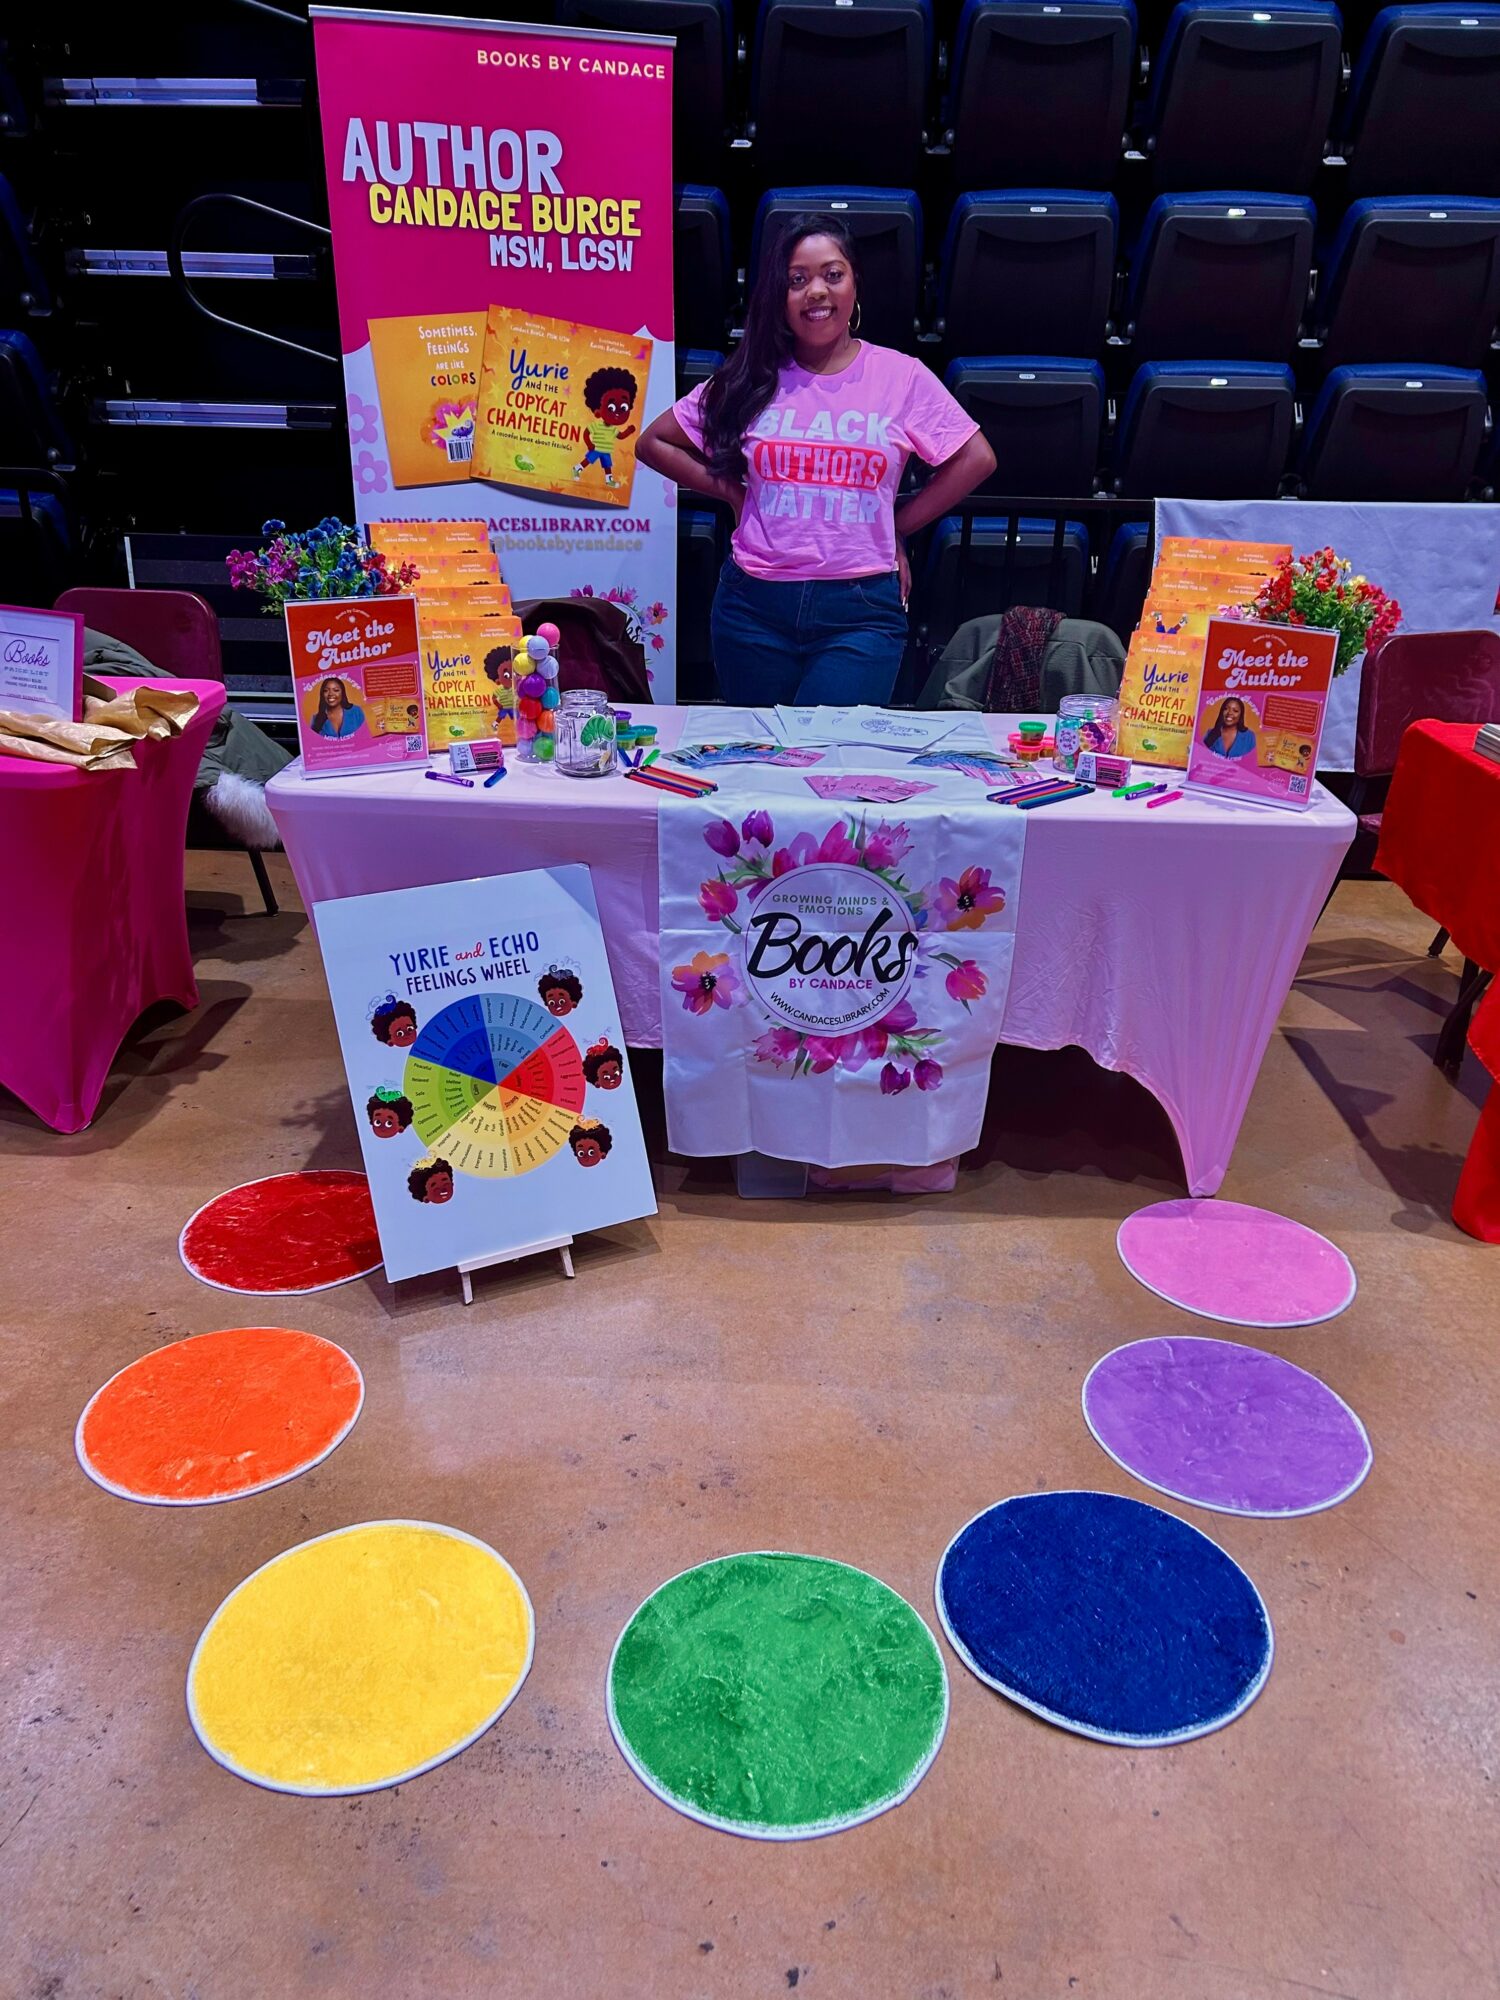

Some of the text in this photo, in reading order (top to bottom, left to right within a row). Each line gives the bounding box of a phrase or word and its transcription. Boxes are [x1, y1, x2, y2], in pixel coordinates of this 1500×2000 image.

[477, 50, 666, 79] BOOKS BY CANDACE
[342, 117, 564, 195] AUTHOR
[369, 183, 642, 237] CANDACE BURGE
[489, 235, 633, 273] MSW, LCSW
[431, 372, 476, 386] COLORS
[509, 348, 569, 391] Yurie
[544, 383, 559, 394] THE
[506, 391, 567, 418] COPYCAT
[487, 407, 582, 443] CHAMELEON
[752, 408, 893, 447] BLACK
[760, 445, 884, 489] AUTHORS
[759, 481, 881, 523] MATTER
[494, 534, 643, 555] @booksbycandace
[305, 626, 361, 653] Meet
[365, 619, 395, 638] the
[3, 639, 51, 667] Books
[318, 641, 392, 670] Author
[427, 650, 472, 681] Yurie
[1217, 648, 1309, 670] Meet the
[432, 680, 475, 694] COPYCAT
[1143, 663, 1189, 694] Yurie
[1225, 667, 1302, 689] Author
[1123, 706, 1195, 728] CHAMELEON
[1138, 694, 1186, 710] COPYCAT
[772, 894, 889, 906] GROWING MINDS &
[798, 905, 863, 916] EMOTIONS
[389, 931, 539, 976] YURIE and ECHO
[747, 907, 919, 984] Books
[406, 957, 531, 995] FEELINGS WHEEL
[789, 978, 873, 990] BY CANDACE
[770, 988, 890, 1026] WWW.CANDACESLIBRARY.COM
